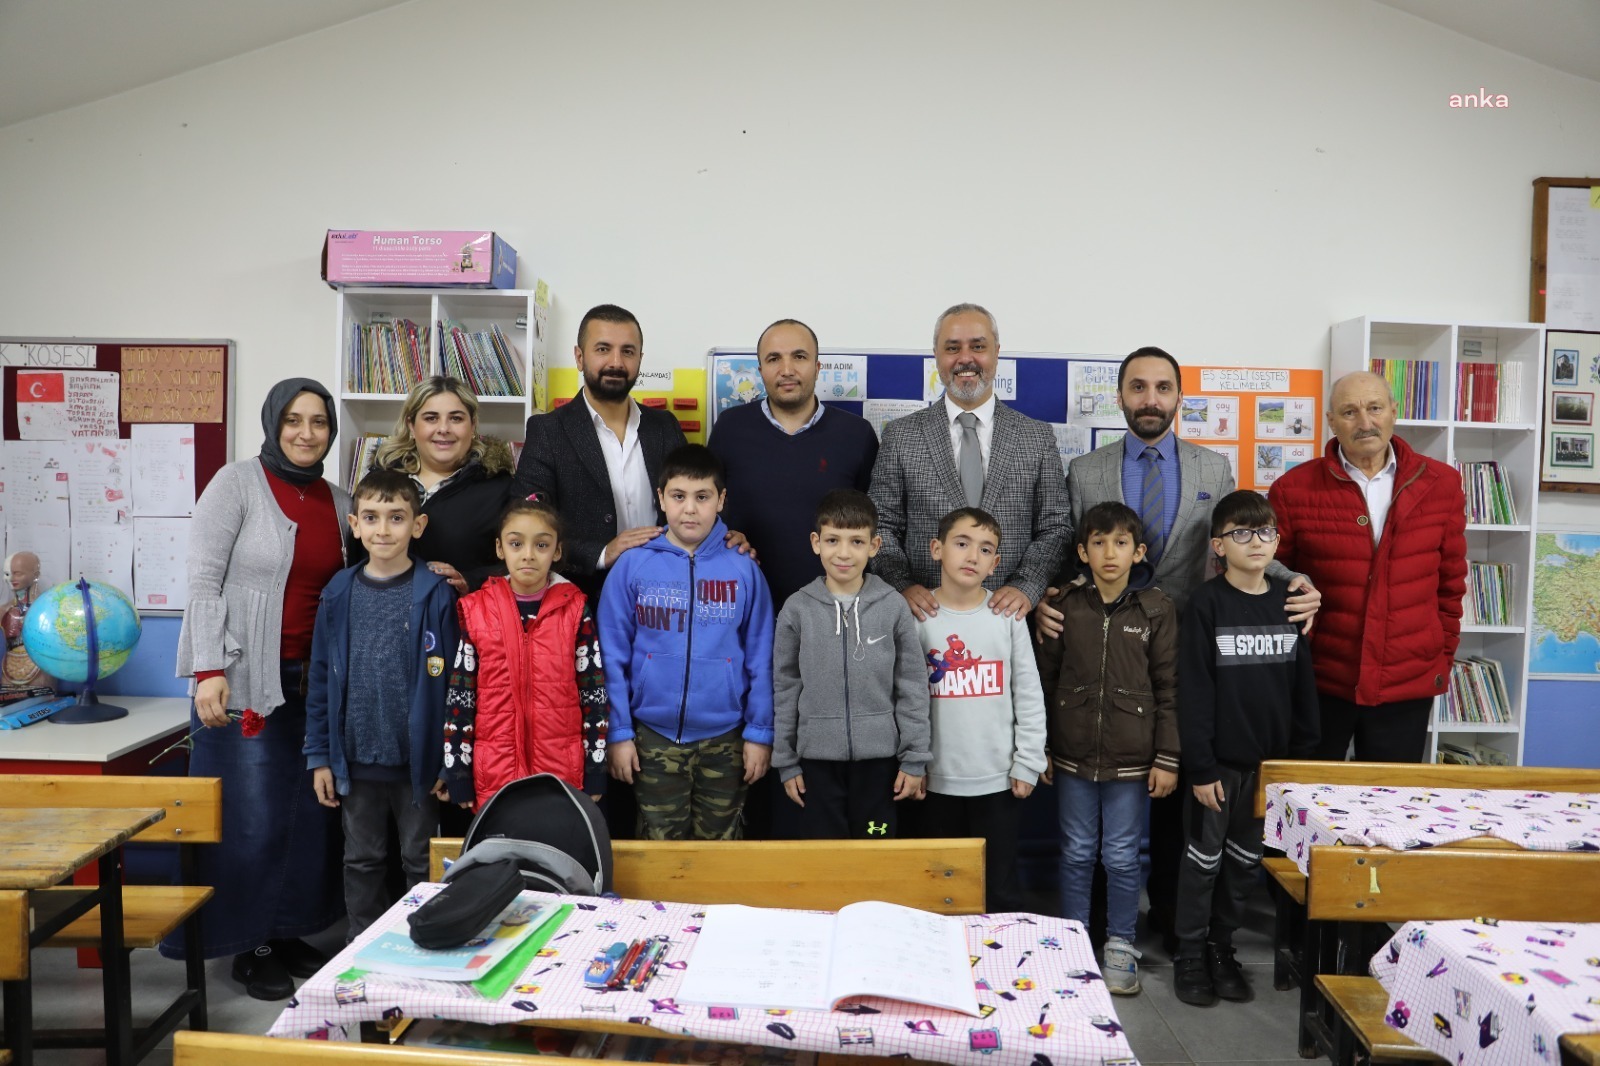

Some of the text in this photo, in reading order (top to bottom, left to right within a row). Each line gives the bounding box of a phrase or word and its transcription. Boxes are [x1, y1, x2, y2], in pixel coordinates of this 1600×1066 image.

[373, 235, 442, 245] Human Torso
[1216, 402, 1230, 412] çay
[1187, 426, 1201, 436] çay
[1292, 448, 1305, 457] dal
[1264, 472, 1276, 480] dal
[697, 578, 737, 604] QUIT
[636, 602, 688, 633] DON'T
[1235, 634, 1284, 655] SPORT
[927, 661, 1001, 696] MARVEL
